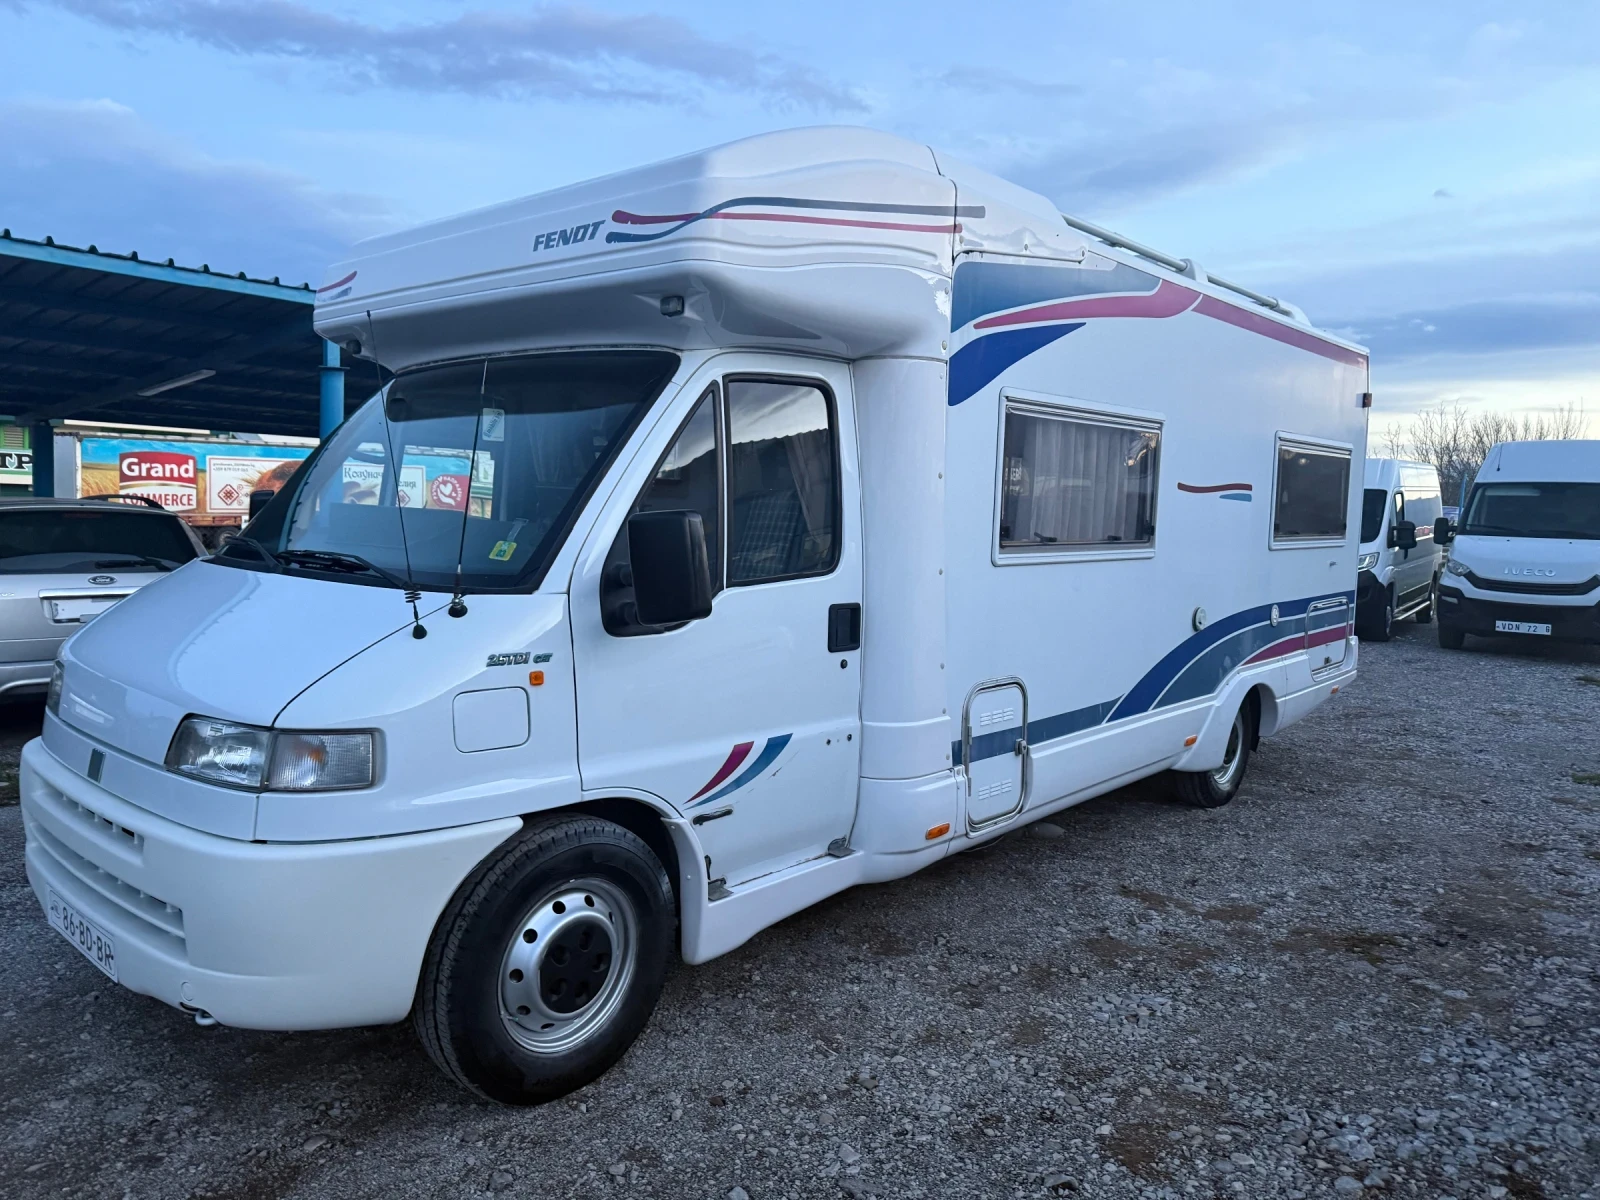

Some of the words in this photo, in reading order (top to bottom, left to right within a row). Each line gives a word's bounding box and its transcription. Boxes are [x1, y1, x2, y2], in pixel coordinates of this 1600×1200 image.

[532, 219, 606, 252] FENDT
[121, 457, 194, 478] Grand
[1503, 567, 1556, 577] IVECO
